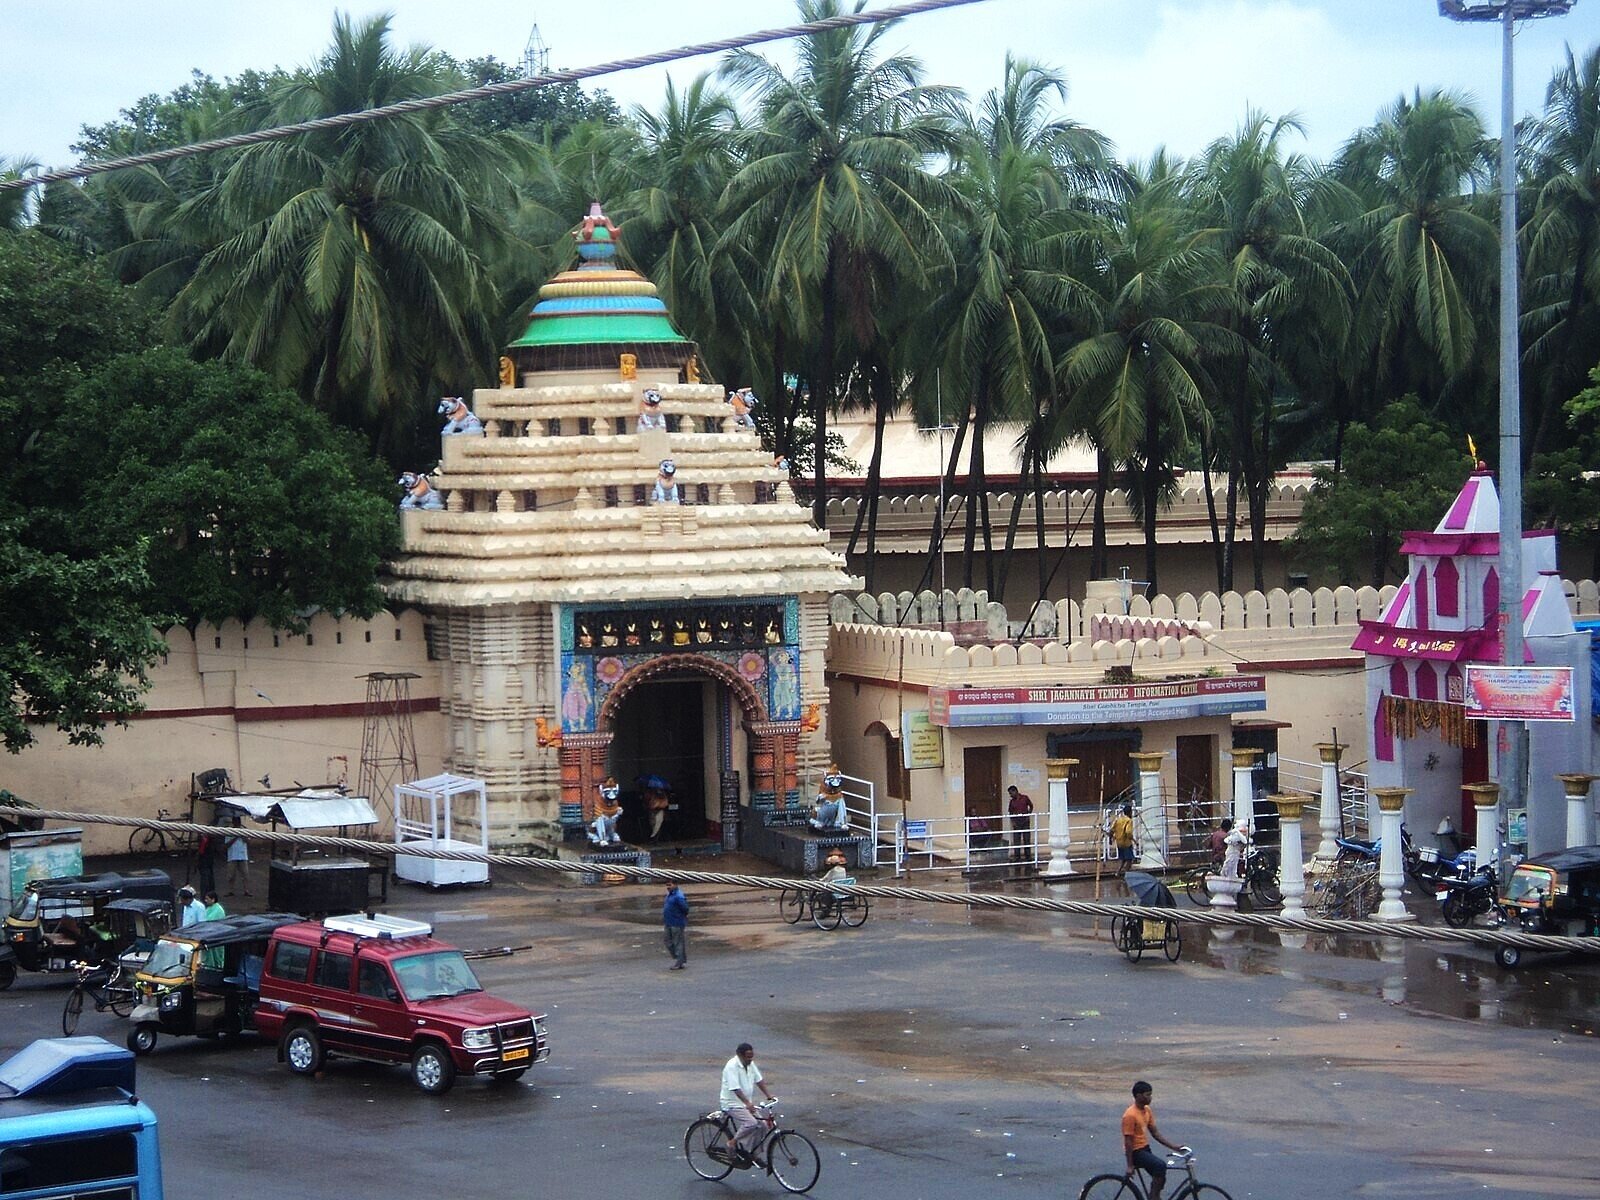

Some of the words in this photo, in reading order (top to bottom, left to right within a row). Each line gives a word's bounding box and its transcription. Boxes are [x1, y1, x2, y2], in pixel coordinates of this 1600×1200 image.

[1028, 690, 1048, 701] SHRI
[1051, 689, 1095, 703] JAGANNATH
[1098, 688, 1129, 699] TEMPLE
[1133, 685, 1179, 698] INFORMATION
[1047, 711, 1081, 720] Donation
[1083, 711, 1090, 720] to
